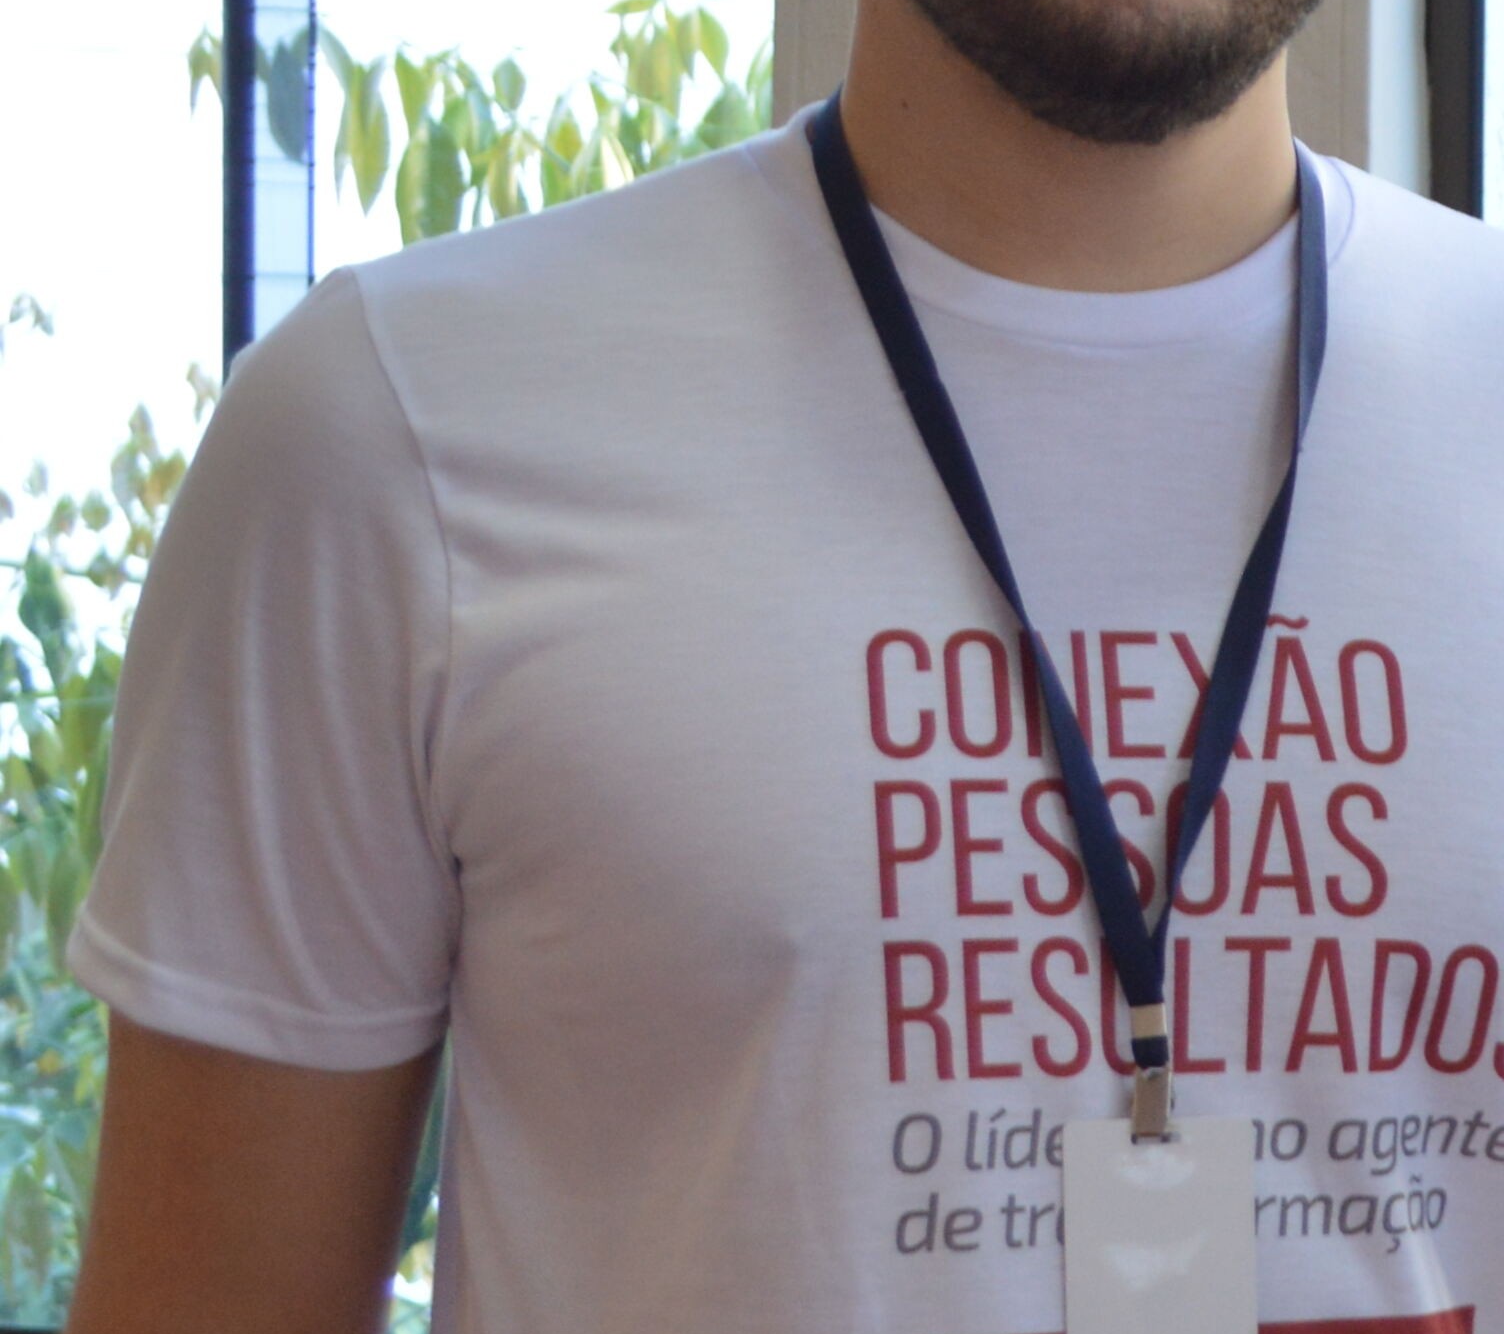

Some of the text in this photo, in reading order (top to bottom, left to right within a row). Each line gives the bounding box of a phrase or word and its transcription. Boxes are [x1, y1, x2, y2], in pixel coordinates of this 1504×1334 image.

[866, 614, 1409, 766] CONEXÃO
[873, 777, 1389, 919] PESSOAS
[893, 1112, 942, 1175] O
[965, 1108, 1064, 1171] líde
[896, 1192, 983, 1254] de
